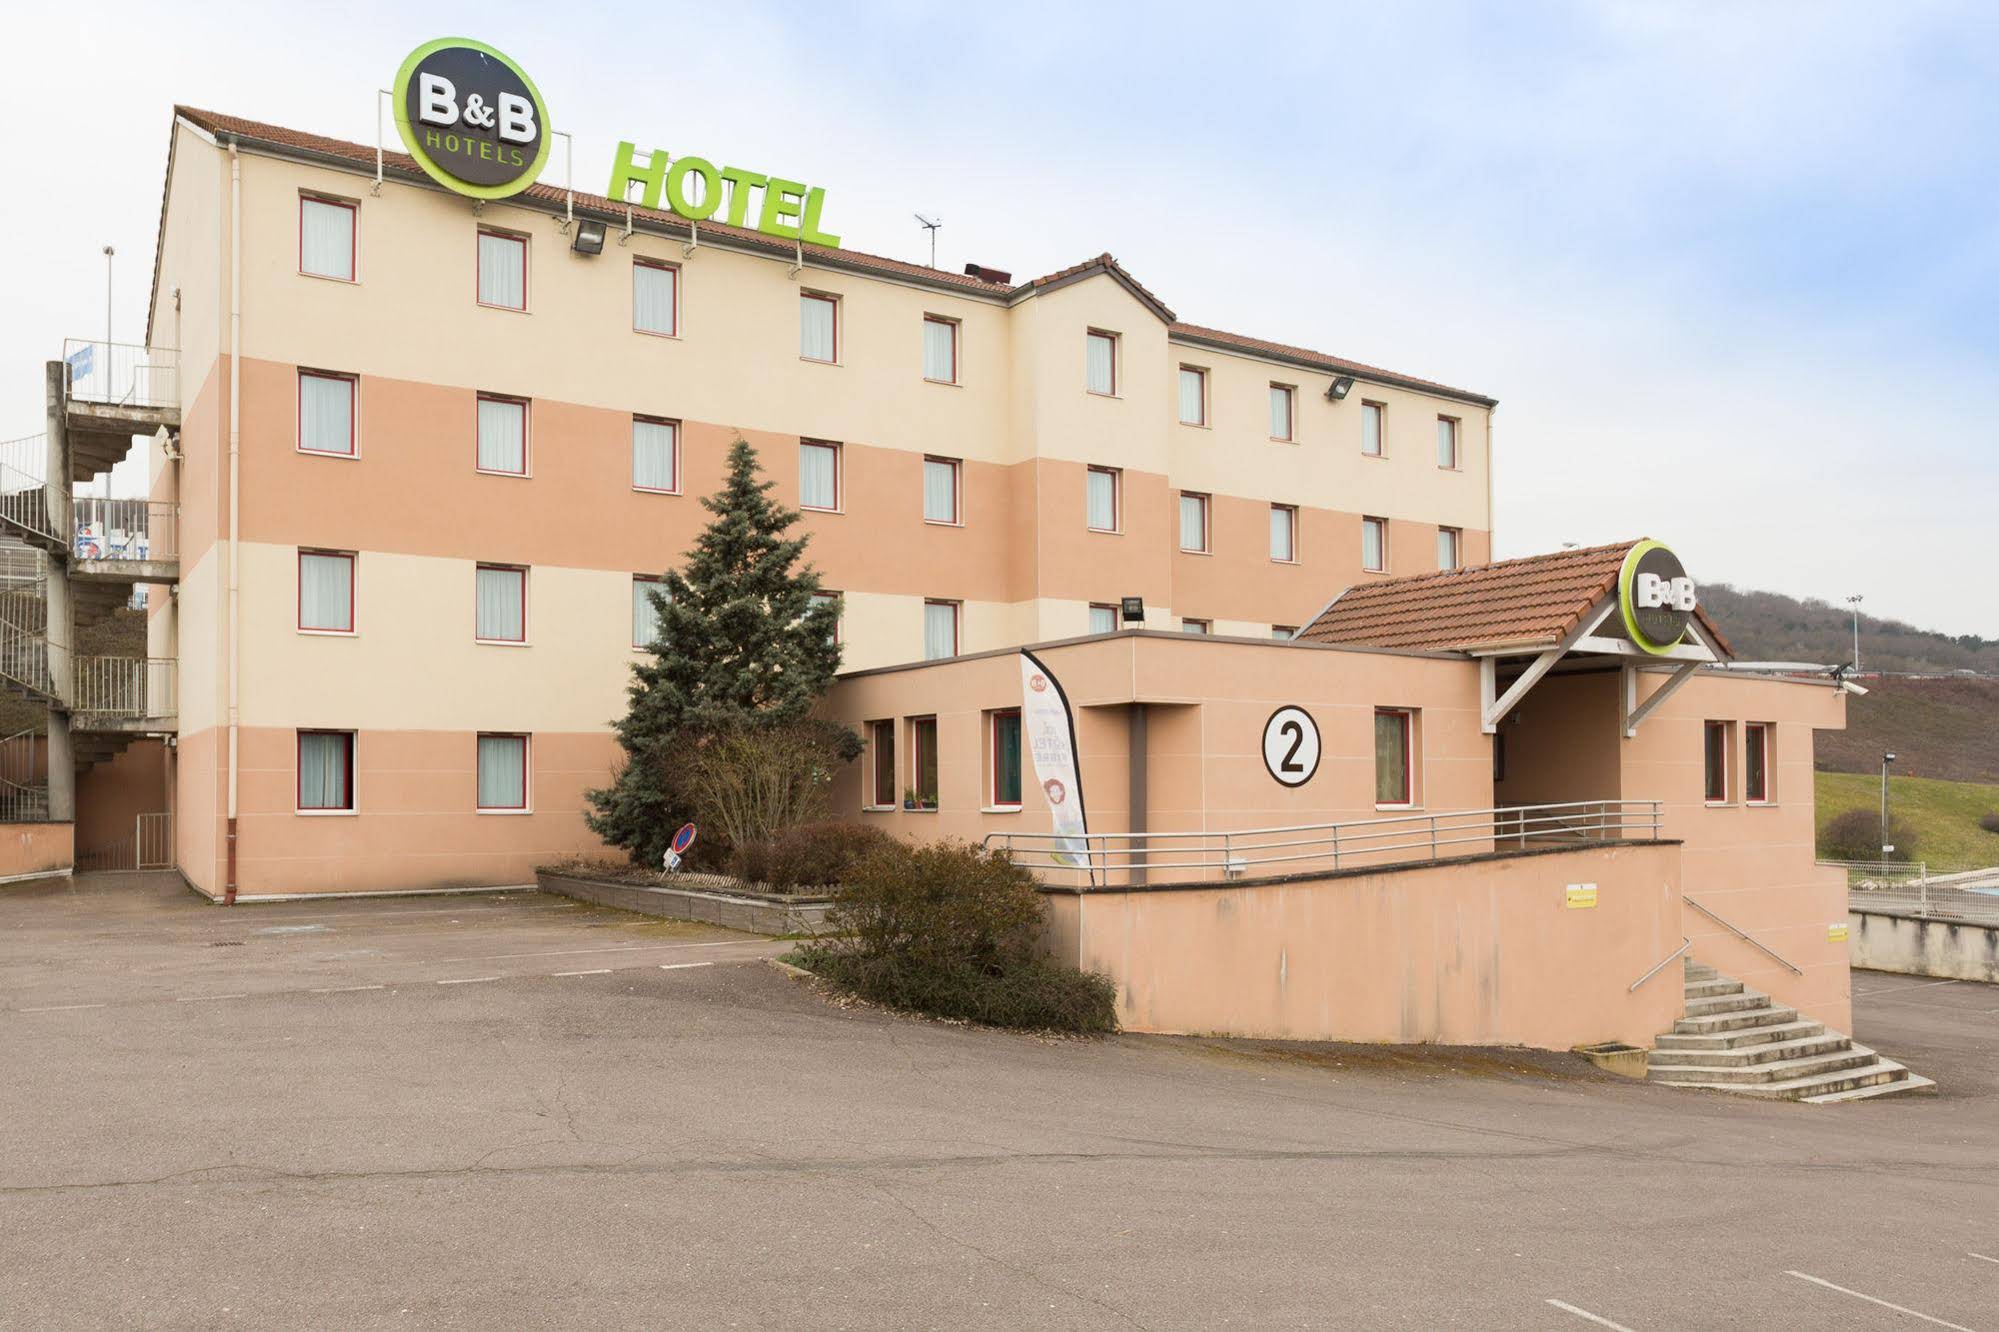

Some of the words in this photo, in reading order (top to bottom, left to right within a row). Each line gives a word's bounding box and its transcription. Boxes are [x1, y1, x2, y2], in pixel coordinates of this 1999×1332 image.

[419, 72, 537, 143] B&B
[426, 129, 525, 167] HOTELS
[607, 141, 841, 249] HOTEL
[1638, 573, 1697, 611] B&B
[1281, 721, 1303, 772] 2
